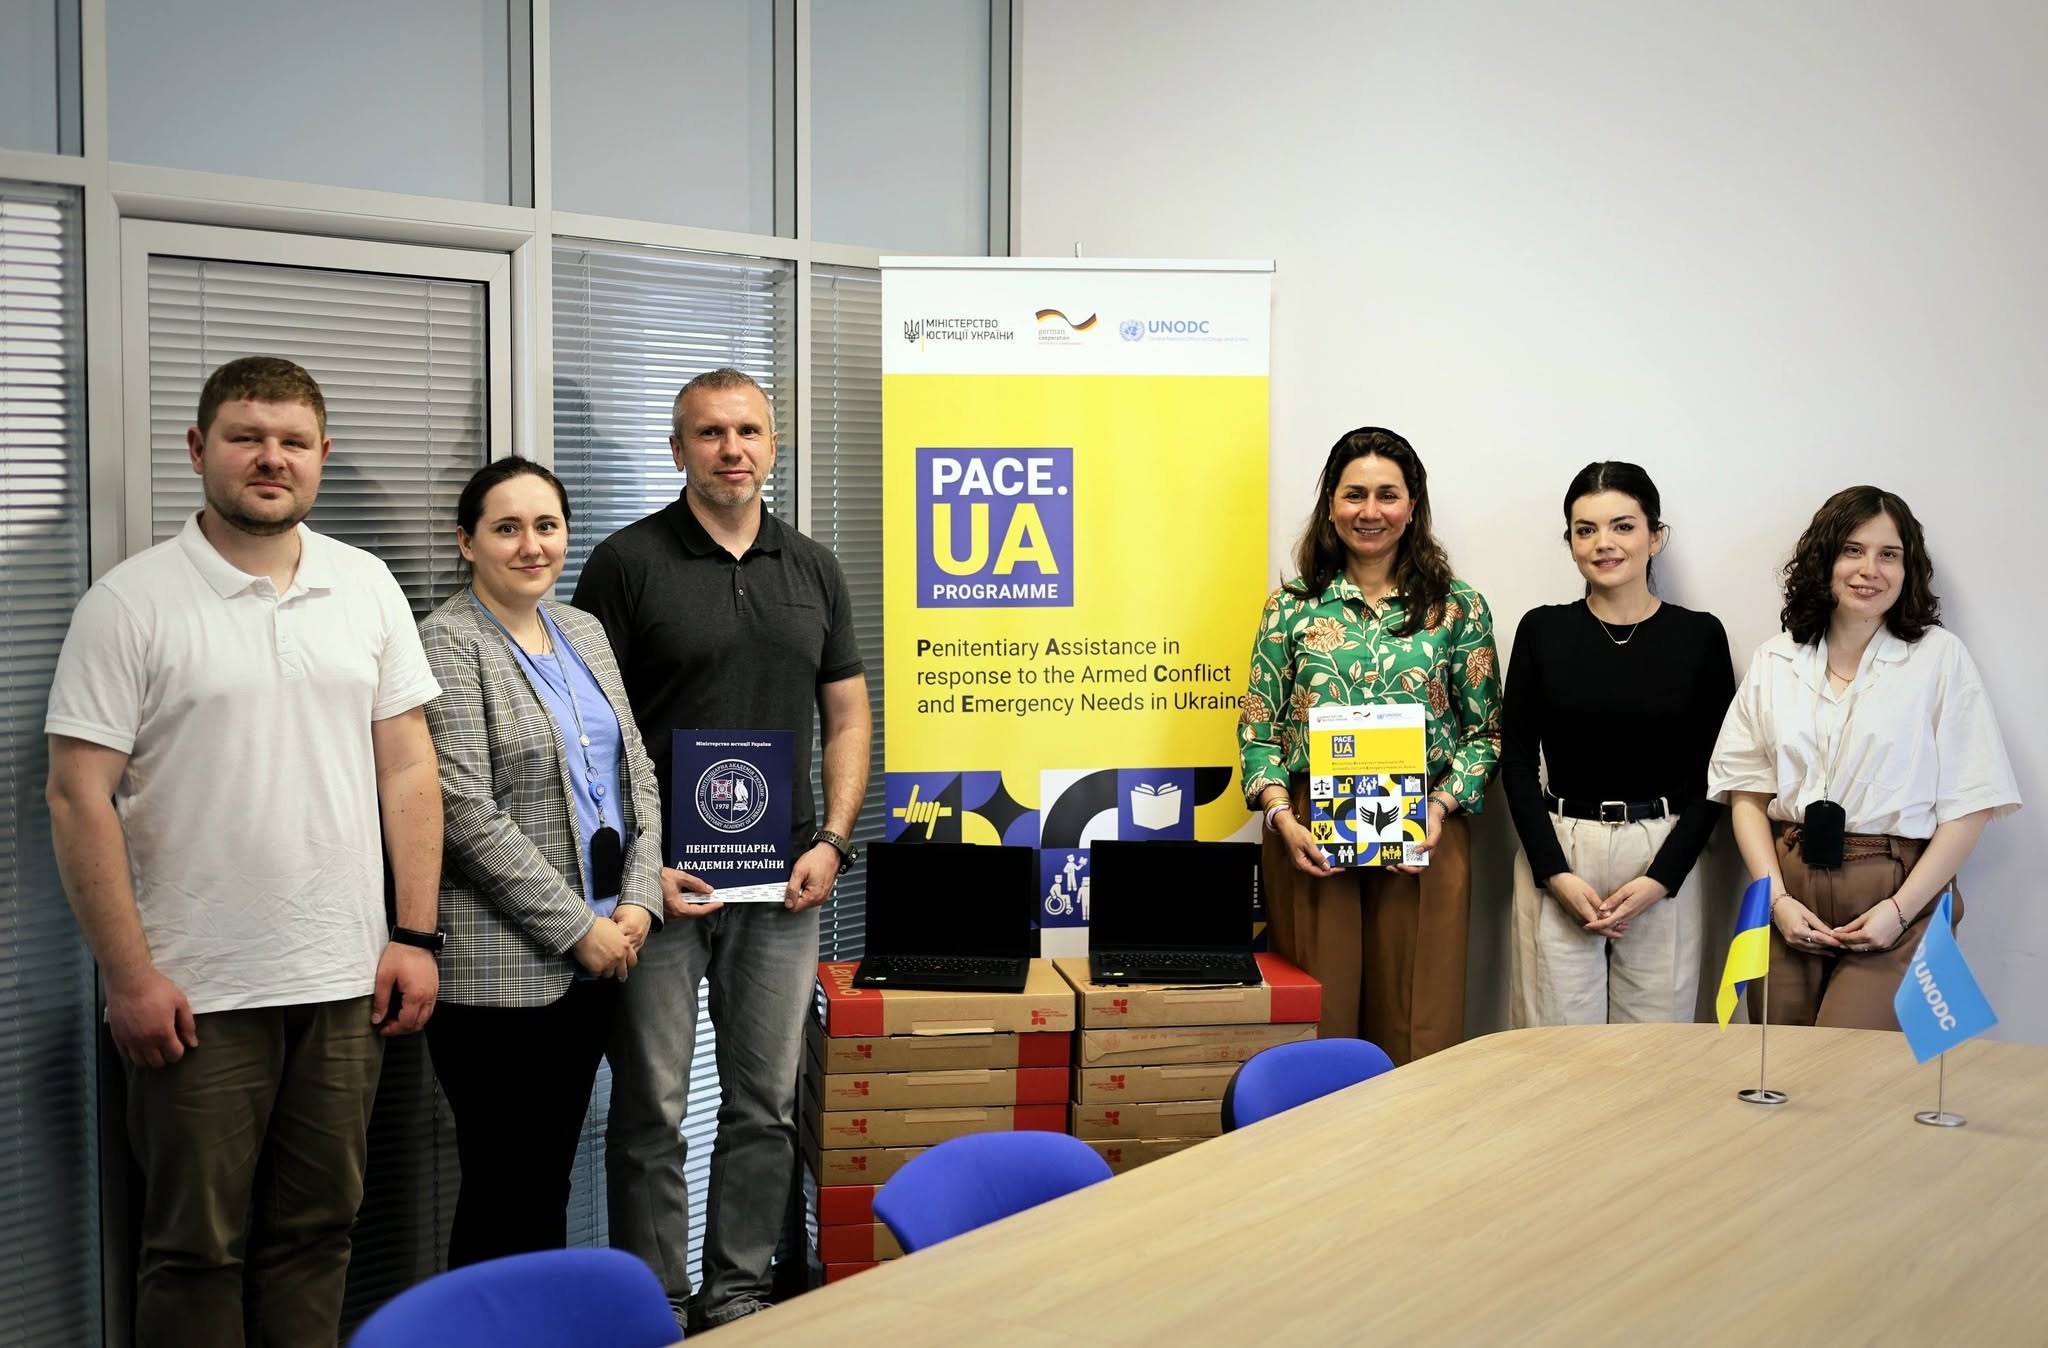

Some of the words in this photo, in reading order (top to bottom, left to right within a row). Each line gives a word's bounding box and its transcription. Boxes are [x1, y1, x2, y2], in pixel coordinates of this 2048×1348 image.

[926, 319, 999, 328] МІНІСТЕРСТВО
[1148, 320, 1210, 333] UNODC
[926, 329, 968, 341] ЮСТИЦІЇ
[971, 329, 1014, 340] УКРАЇНИ
[932, 457, 1068, 496] PACE.
[932, 503, 1060, 576] UA
[933, 583, 1059, 600] PROGRAMME
[916, 639, 1039, 661] Penitentiary
[1045, 638, 1157, 656] Assistance
[1163, 637, 1180, 655] in
[917, 668, 1011, 689] response
[1018, 667, 1037, 684] to
[1044, 664, 1075, 684] the
[1081, 664, 1148, 683] Armed
[1153, 663, 1232, 683] Conflict
[917, 695, 955, 714] and
[961, 695, 1074, 716] Emergency
[1081, 693, 1145, 711] Needs
[1151, 692, 1168, 710] in
[1174, 692, 1246, 710] Ukraine
[1334, 743, 1353, 753] UA
[685, 844, 776, 855] ПЕНІТЕНЦІАРНА
[676, 860, 734, 871] АКАДЕМІЯ
[736, 859, 785, 870] УКРАЇНИ
[1914, 961, 1956, 1031] UNODC
